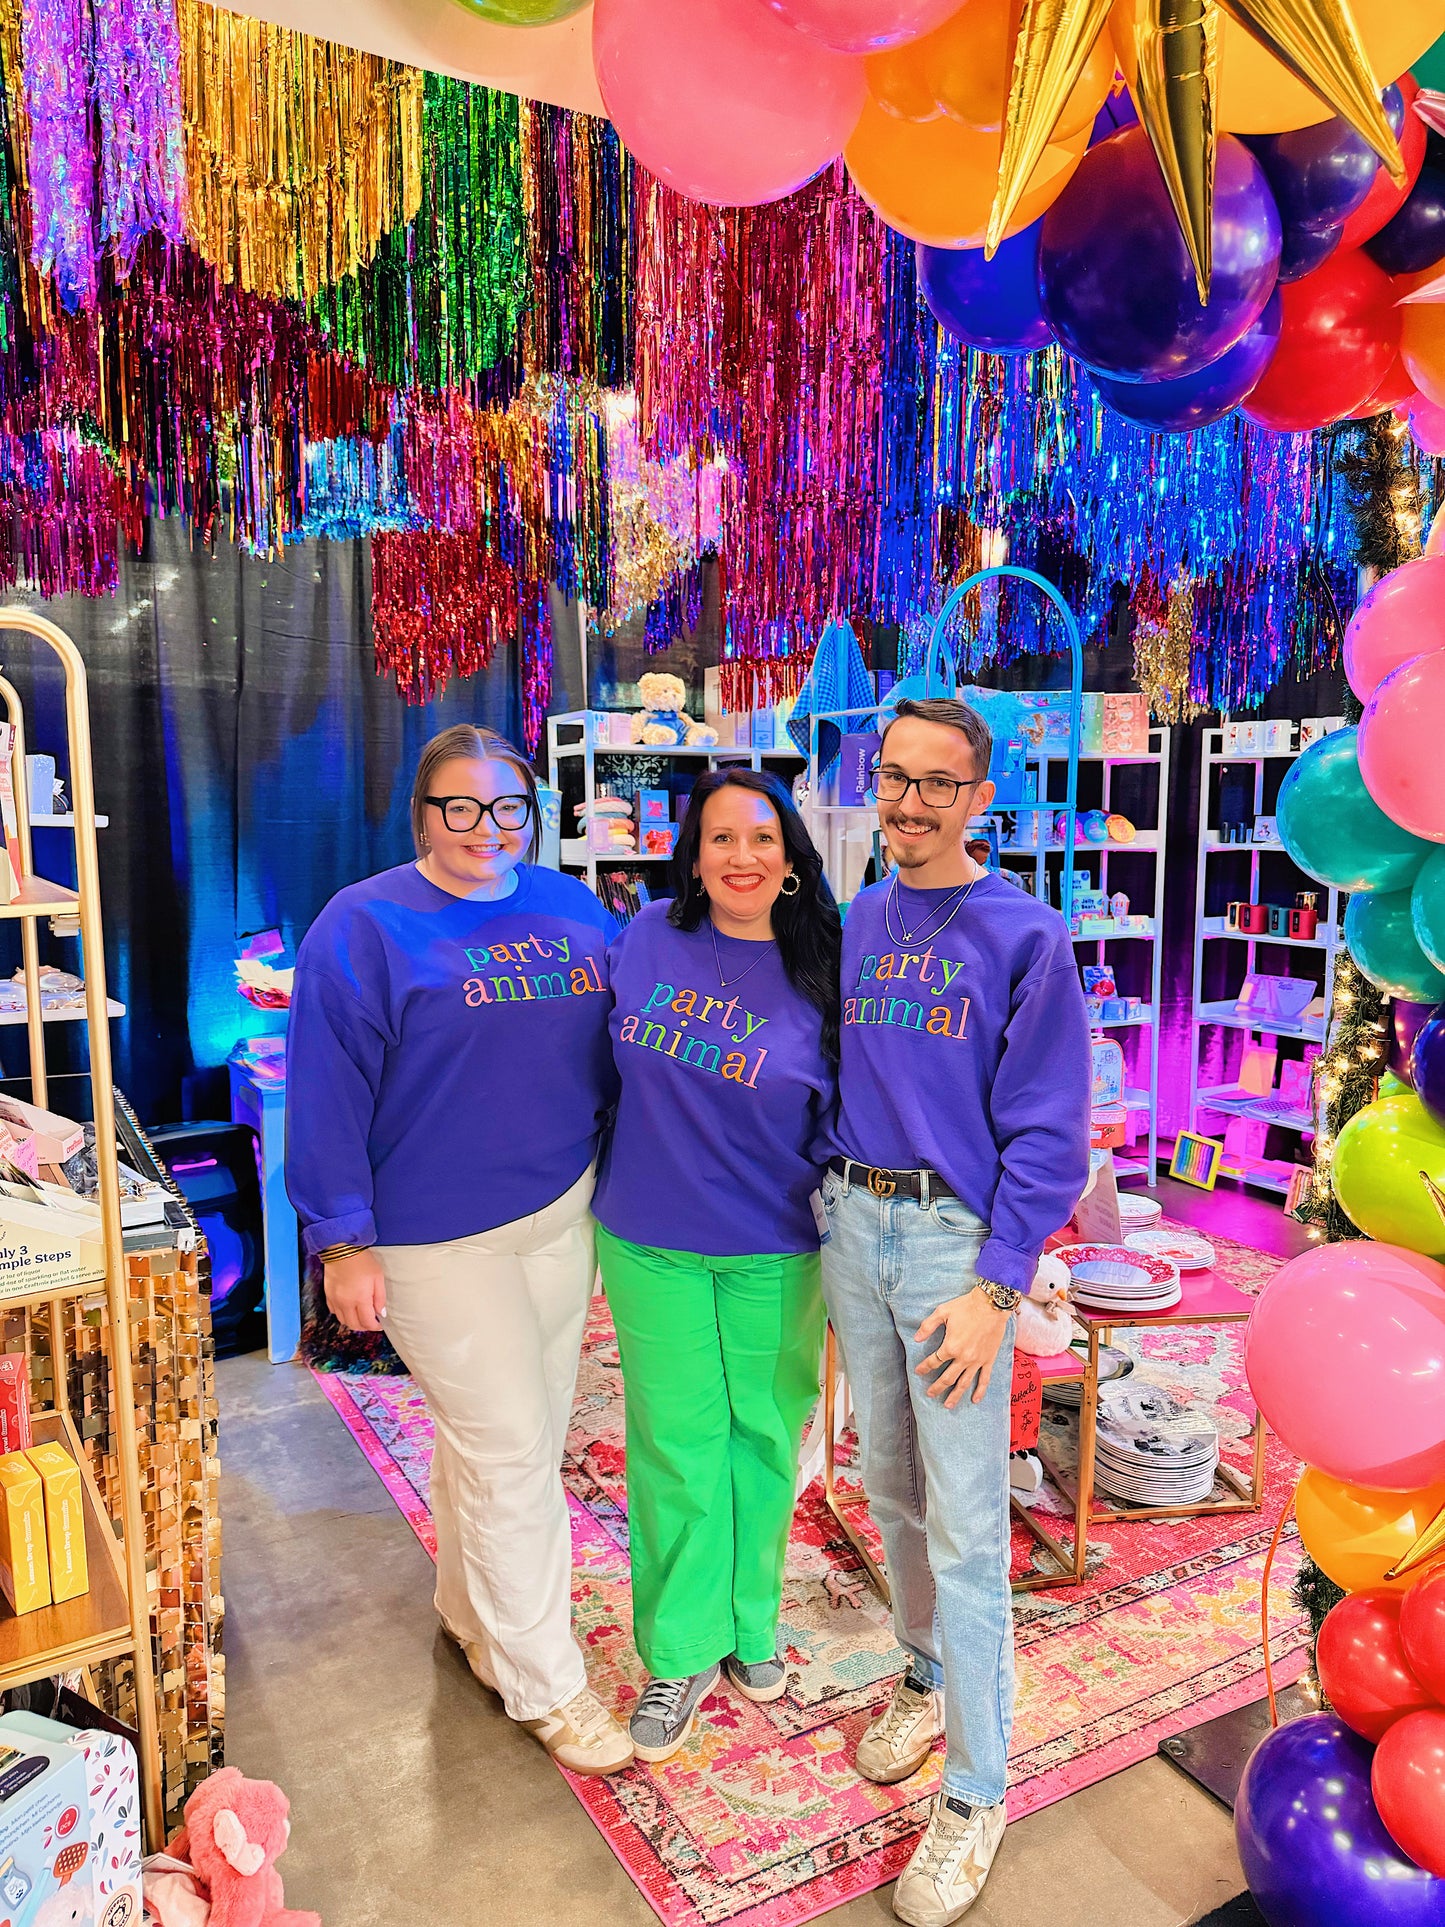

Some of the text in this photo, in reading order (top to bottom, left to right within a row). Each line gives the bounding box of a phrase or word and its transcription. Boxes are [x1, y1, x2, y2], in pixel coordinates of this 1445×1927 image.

[855, 748, 866, 793] Rainbow
[464, 932, 571, 973] party
[855, 945, 965, 996] party
[462, 956, 607, 1008] animal
[640, 982, 769, 1043] party
[844, 985, 971, 1040] animal
[620, 1015, 768, 1090] animal
[0, 1245, 28, 1259] ly 3
[0, 1250, 72, 1271] mple Steps
[25, 1272, 52, 1283] sparkling
[70, 1266, 87, 1274] water
[64, 1531, 72, 1550] Drop
